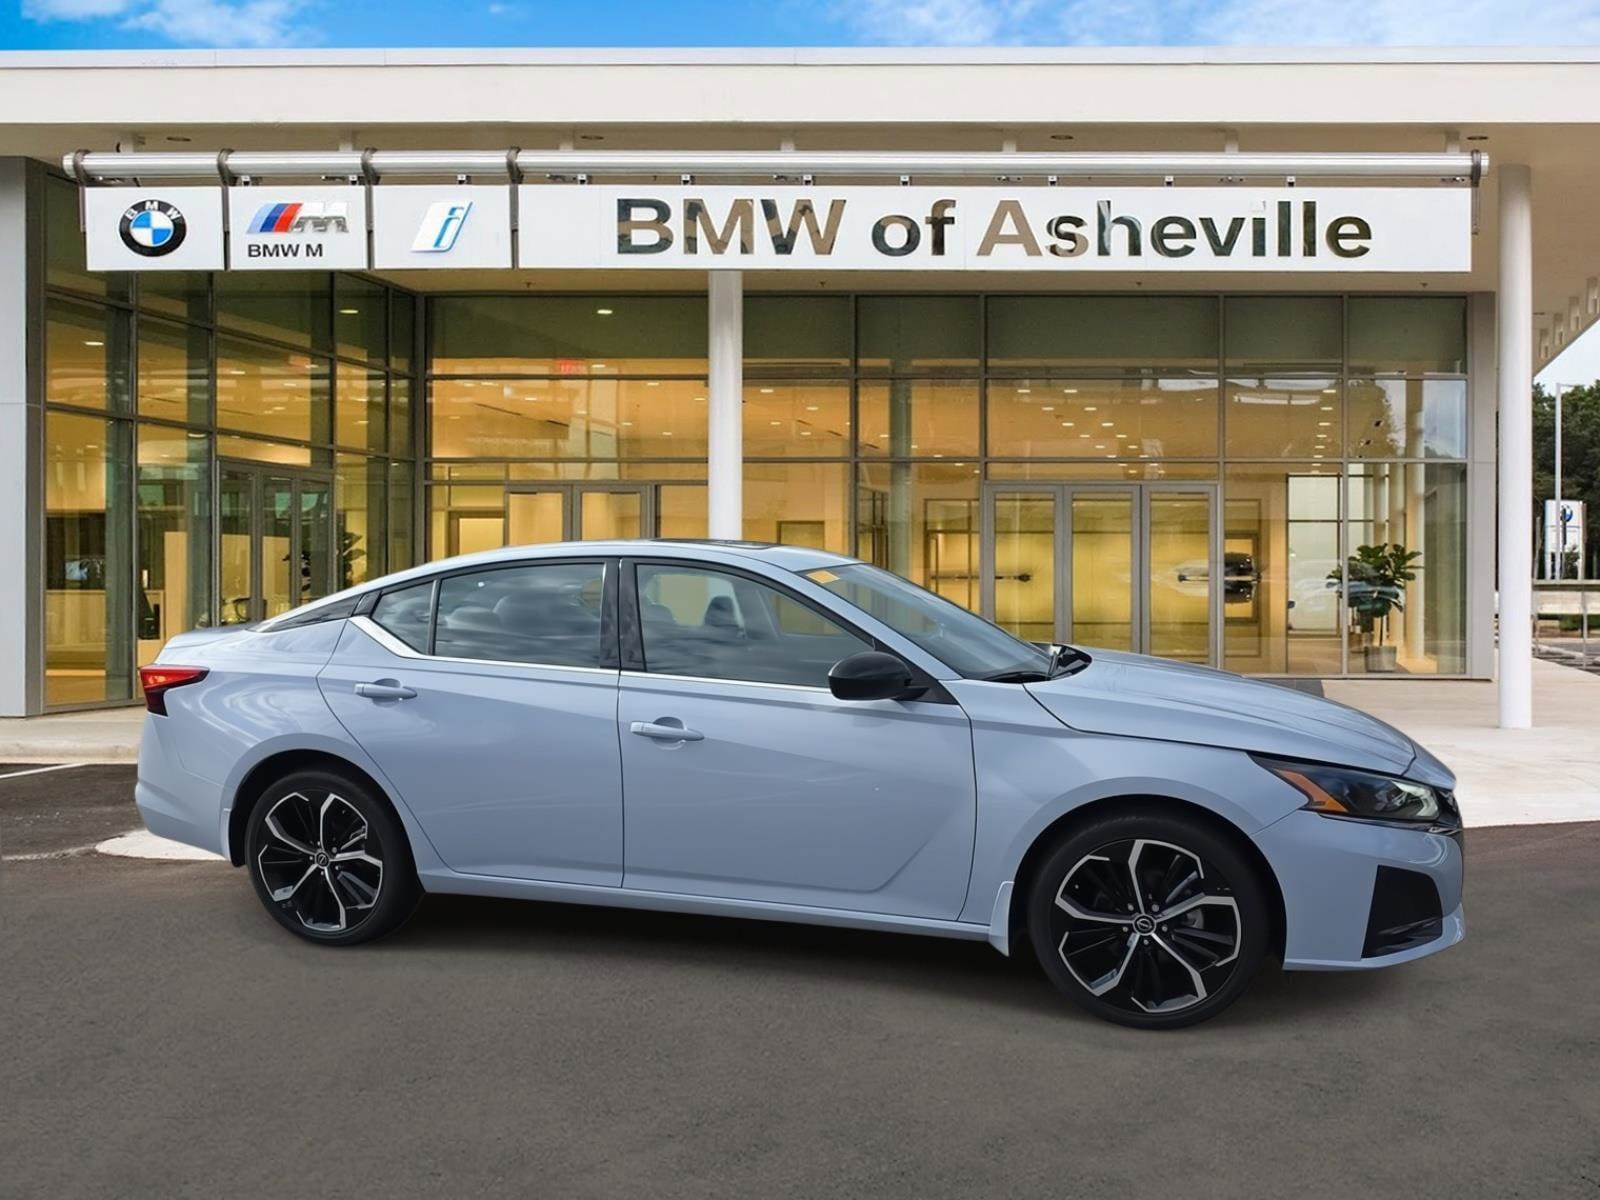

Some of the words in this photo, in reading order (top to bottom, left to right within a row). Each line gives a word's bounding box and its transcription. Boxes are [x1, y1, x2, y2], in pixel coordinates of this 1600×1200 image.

[124, 200, 182, 220] BMW
[616, 198, 847, 256] BMW
[871, 198, 957, 257] of
[976, 199, 1373, 258] Asheville
[247, 243, 300, 258] BMW
[305, 243, 323, 258] M
